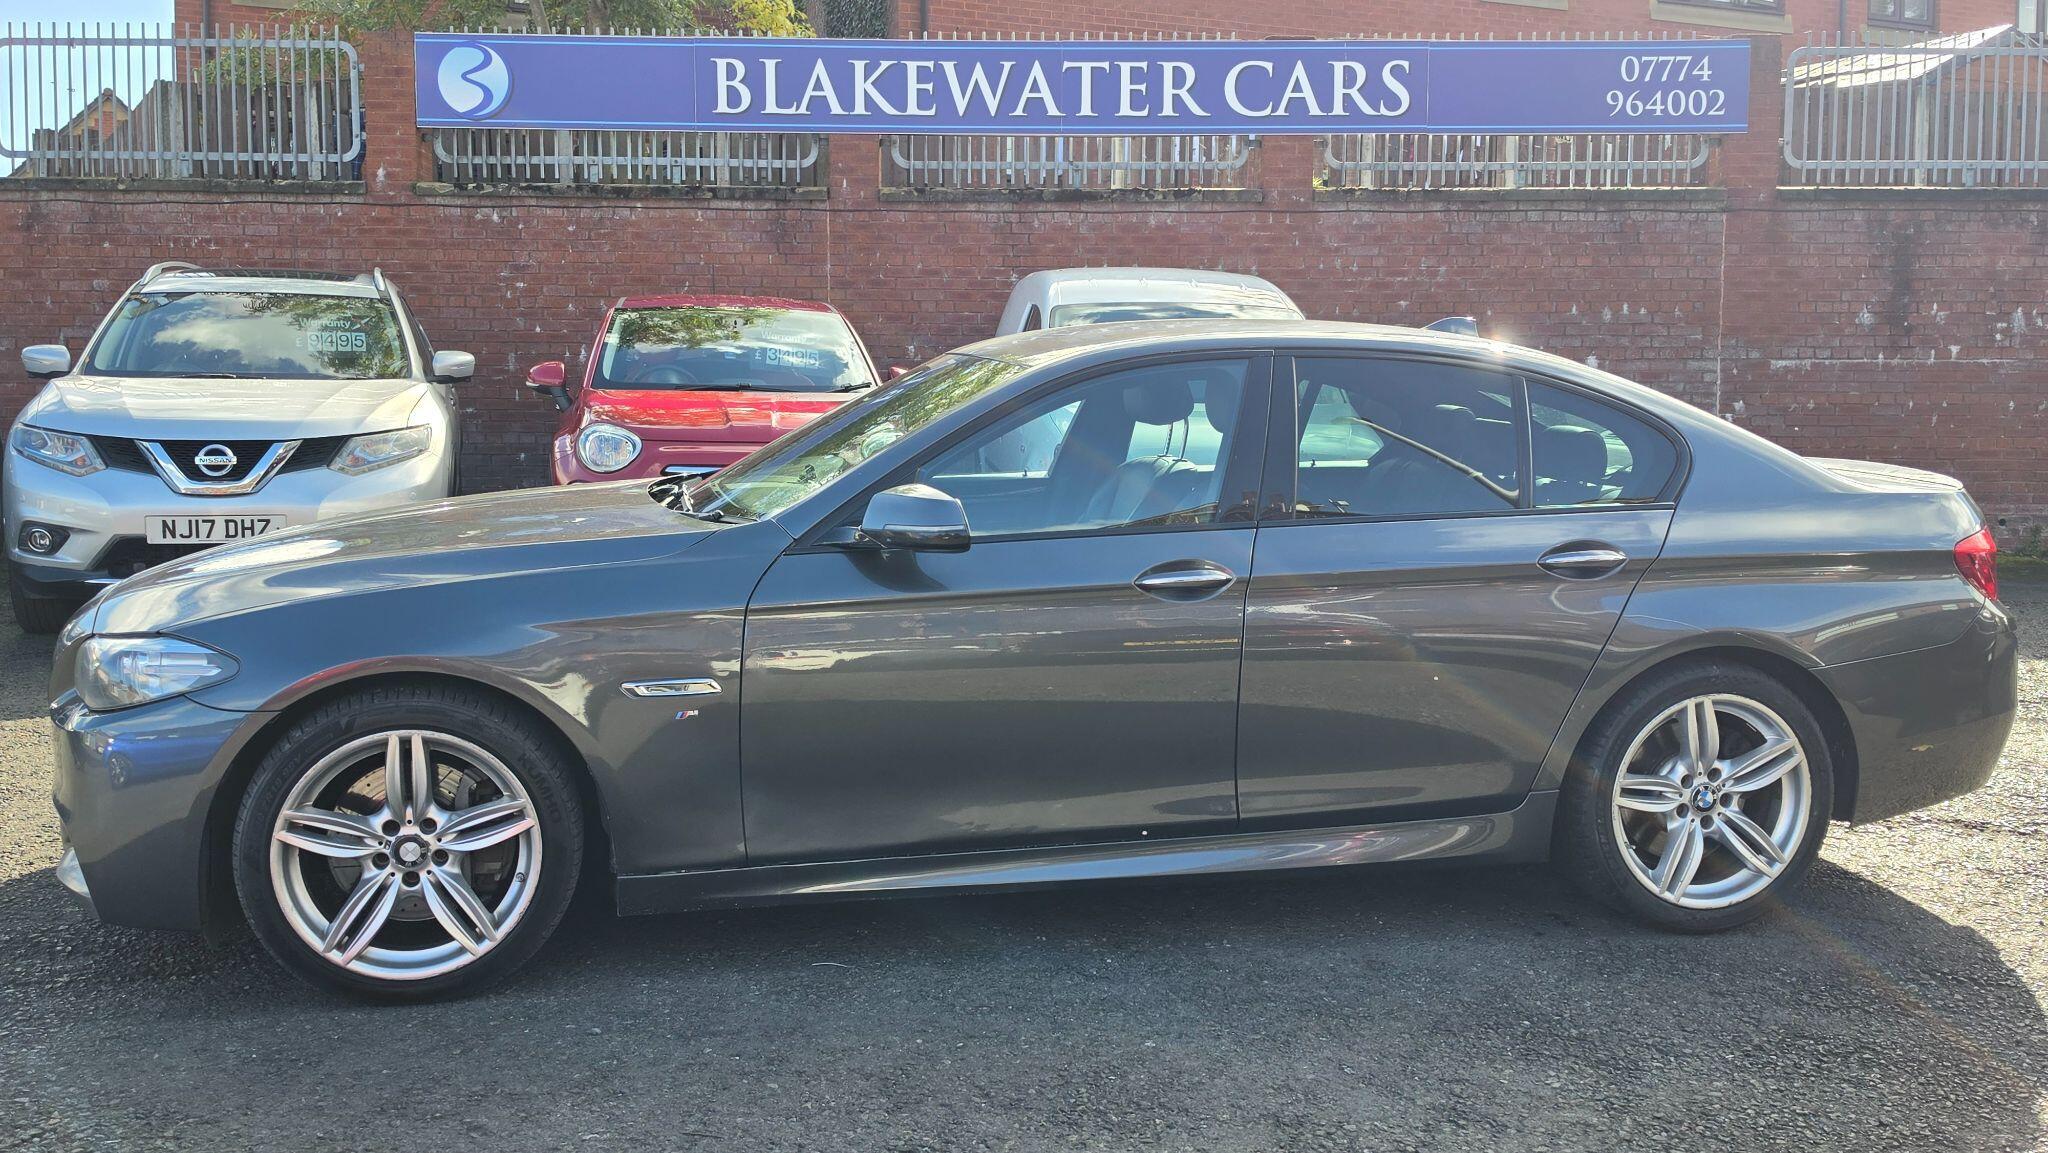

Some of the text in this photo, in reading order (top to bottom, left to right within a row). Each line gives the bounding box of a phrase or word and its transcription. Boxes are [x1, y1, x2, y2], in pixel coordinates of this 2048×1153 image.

[1620, 55, 1713, 82] 07774
[710, 57, 1411, 117] BLAKEWATER CARS
[1606, 89, 1726, 117] 964002
[161, 519, 216, 539] NJ17
